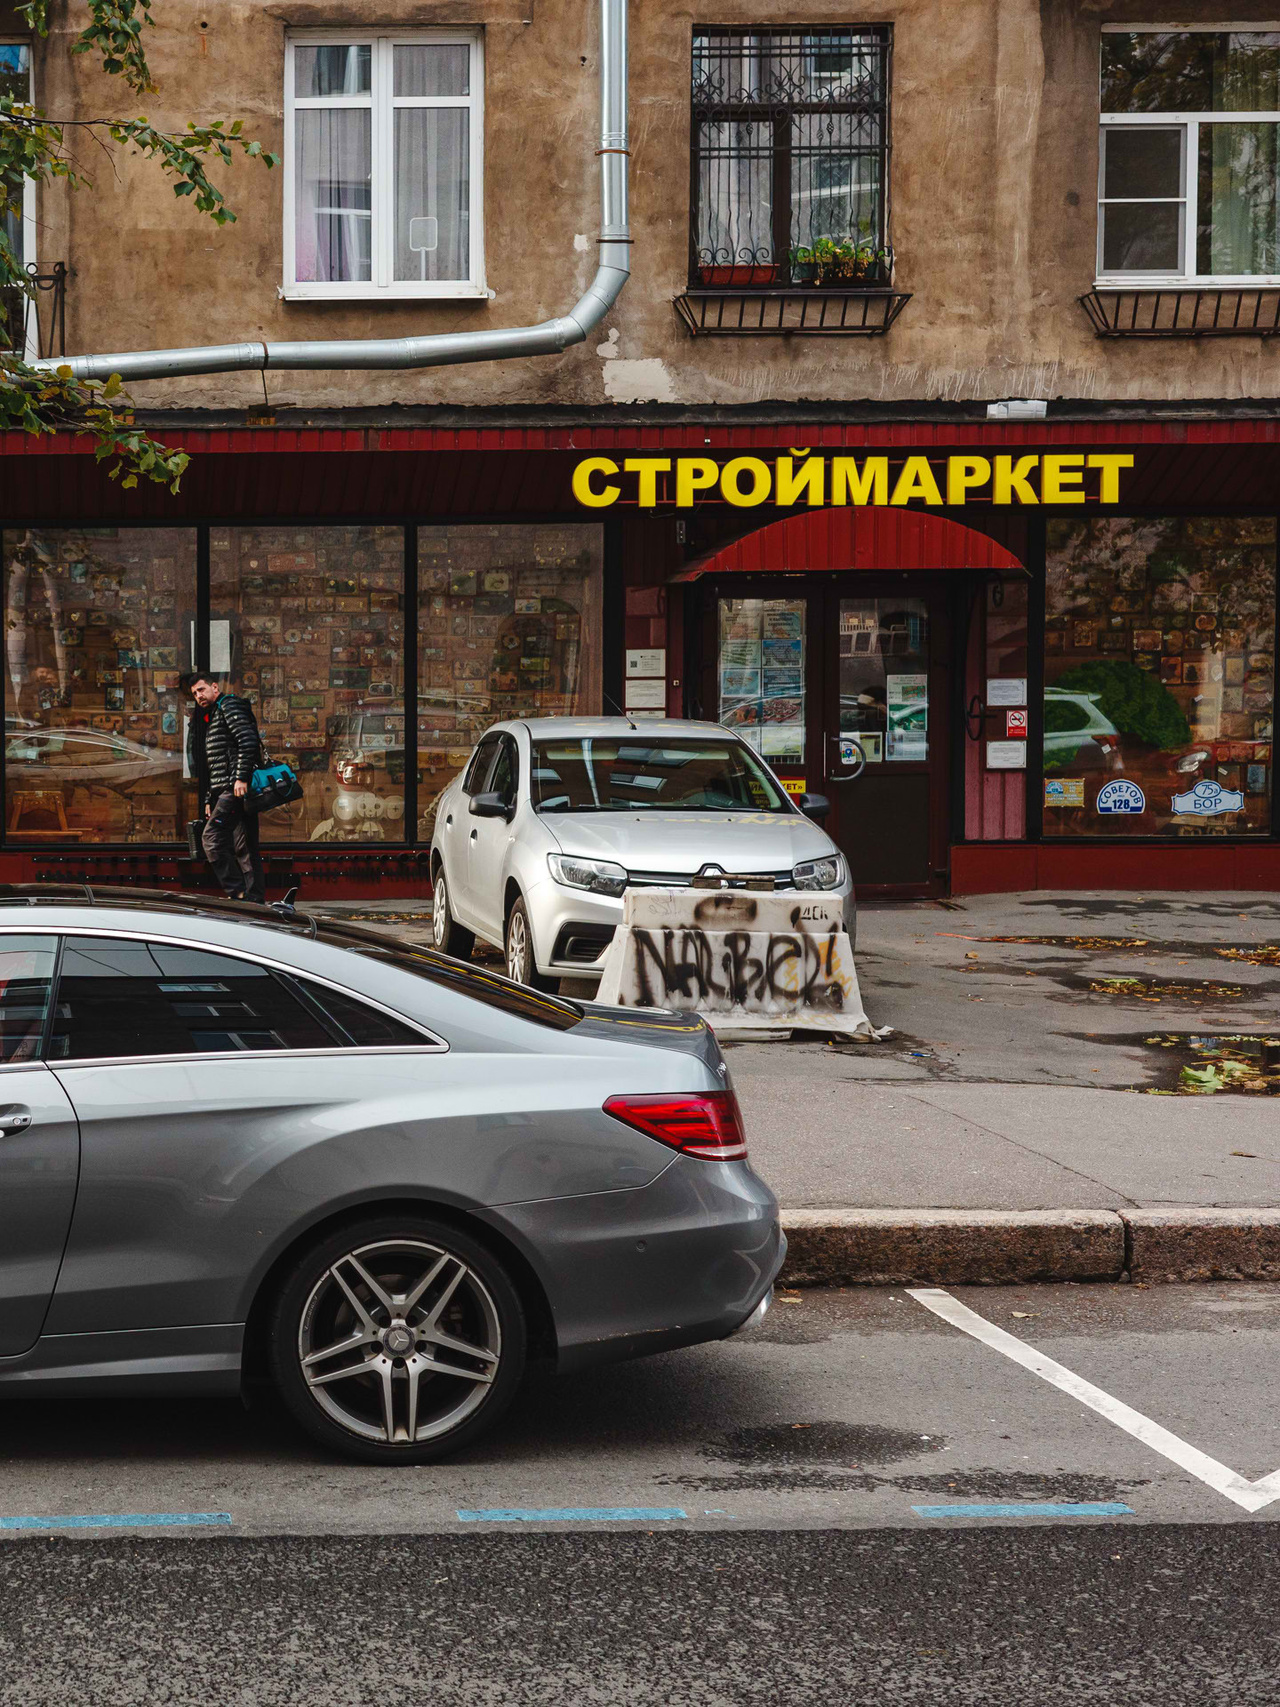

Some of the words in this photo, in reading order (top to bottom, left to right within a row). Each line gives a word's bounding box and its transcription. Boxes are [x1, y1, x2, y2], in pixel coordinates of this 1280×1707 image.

[572, 447, 1134, 507] СТРОЙМАРКЕТ
[1100, 784, 1141, 805] СОВЕТОВ
[1112, 798, 1130, 810] 128
[1193, 798, 1222, 809] БОР
